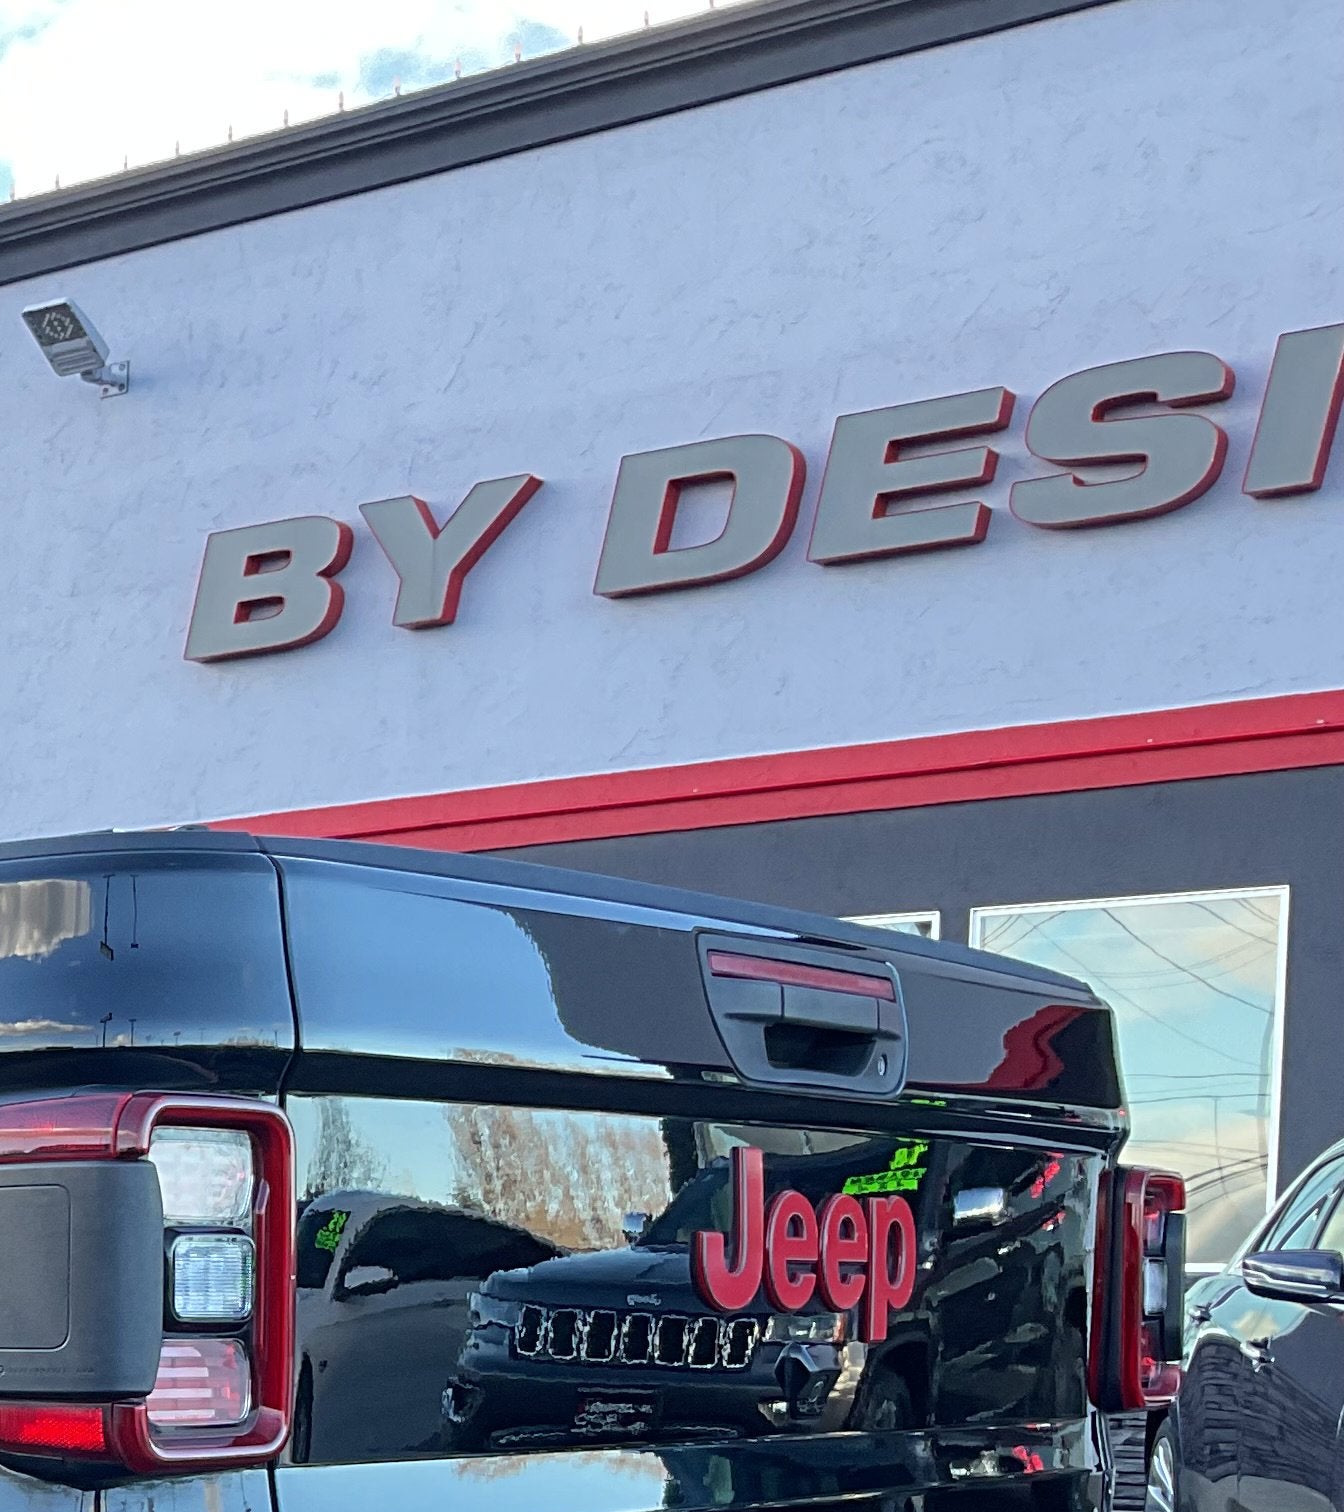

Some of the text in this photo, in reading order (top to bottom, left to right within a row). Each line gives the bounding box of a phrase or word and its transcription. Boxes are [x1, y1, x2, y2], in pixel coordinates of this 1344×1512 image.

[184, 322, 1344, 663] BY DESI
[696, 1147, 916, 1341] Jeep
